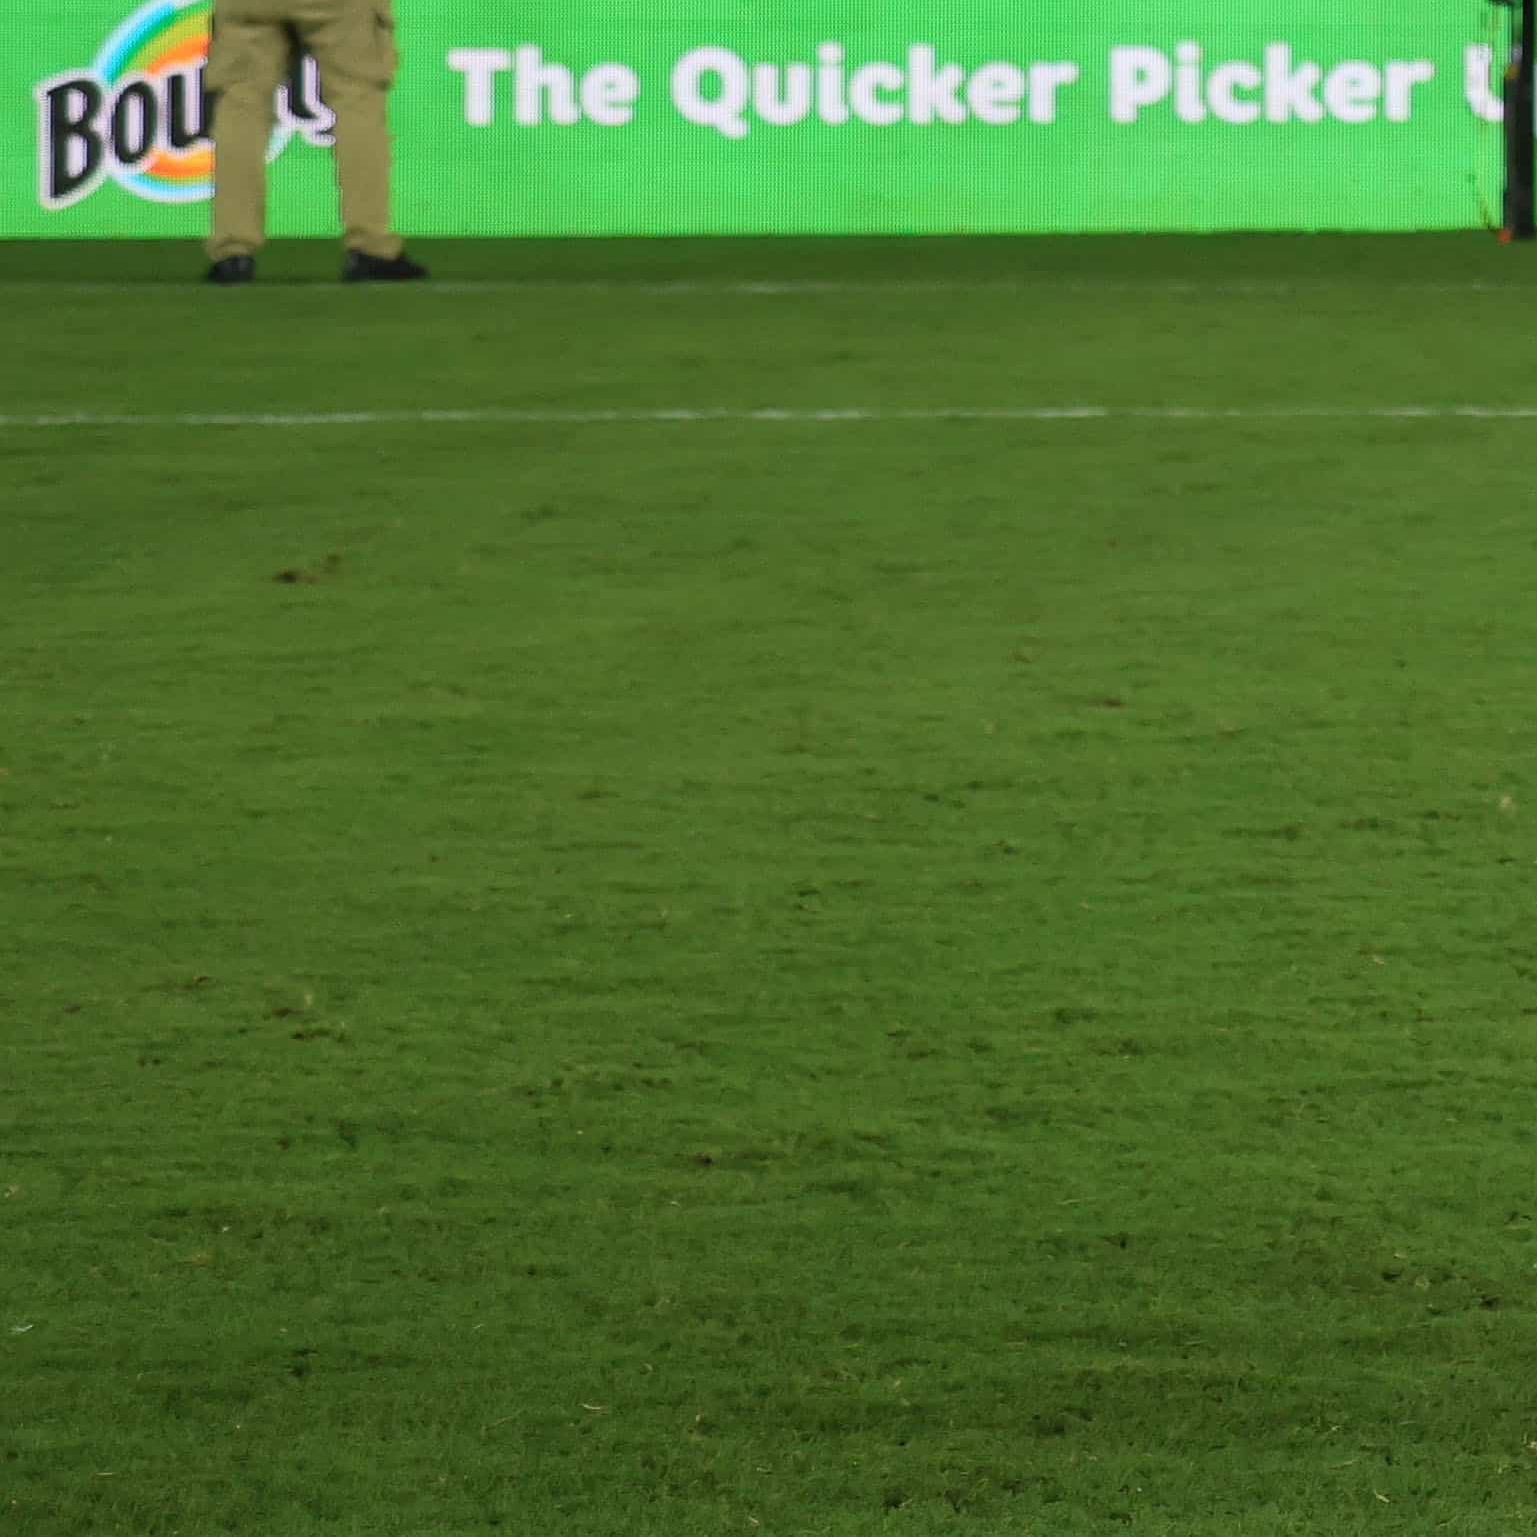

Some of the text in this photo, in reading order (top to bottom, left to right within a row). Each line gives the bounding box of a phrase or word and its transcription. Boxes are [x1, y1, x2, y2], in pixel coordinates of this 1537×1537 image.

[447, 43, 641, 125] The
[670, 41, 1079, 139] Quicker
[1108, 39, 1434, 123] Picker
